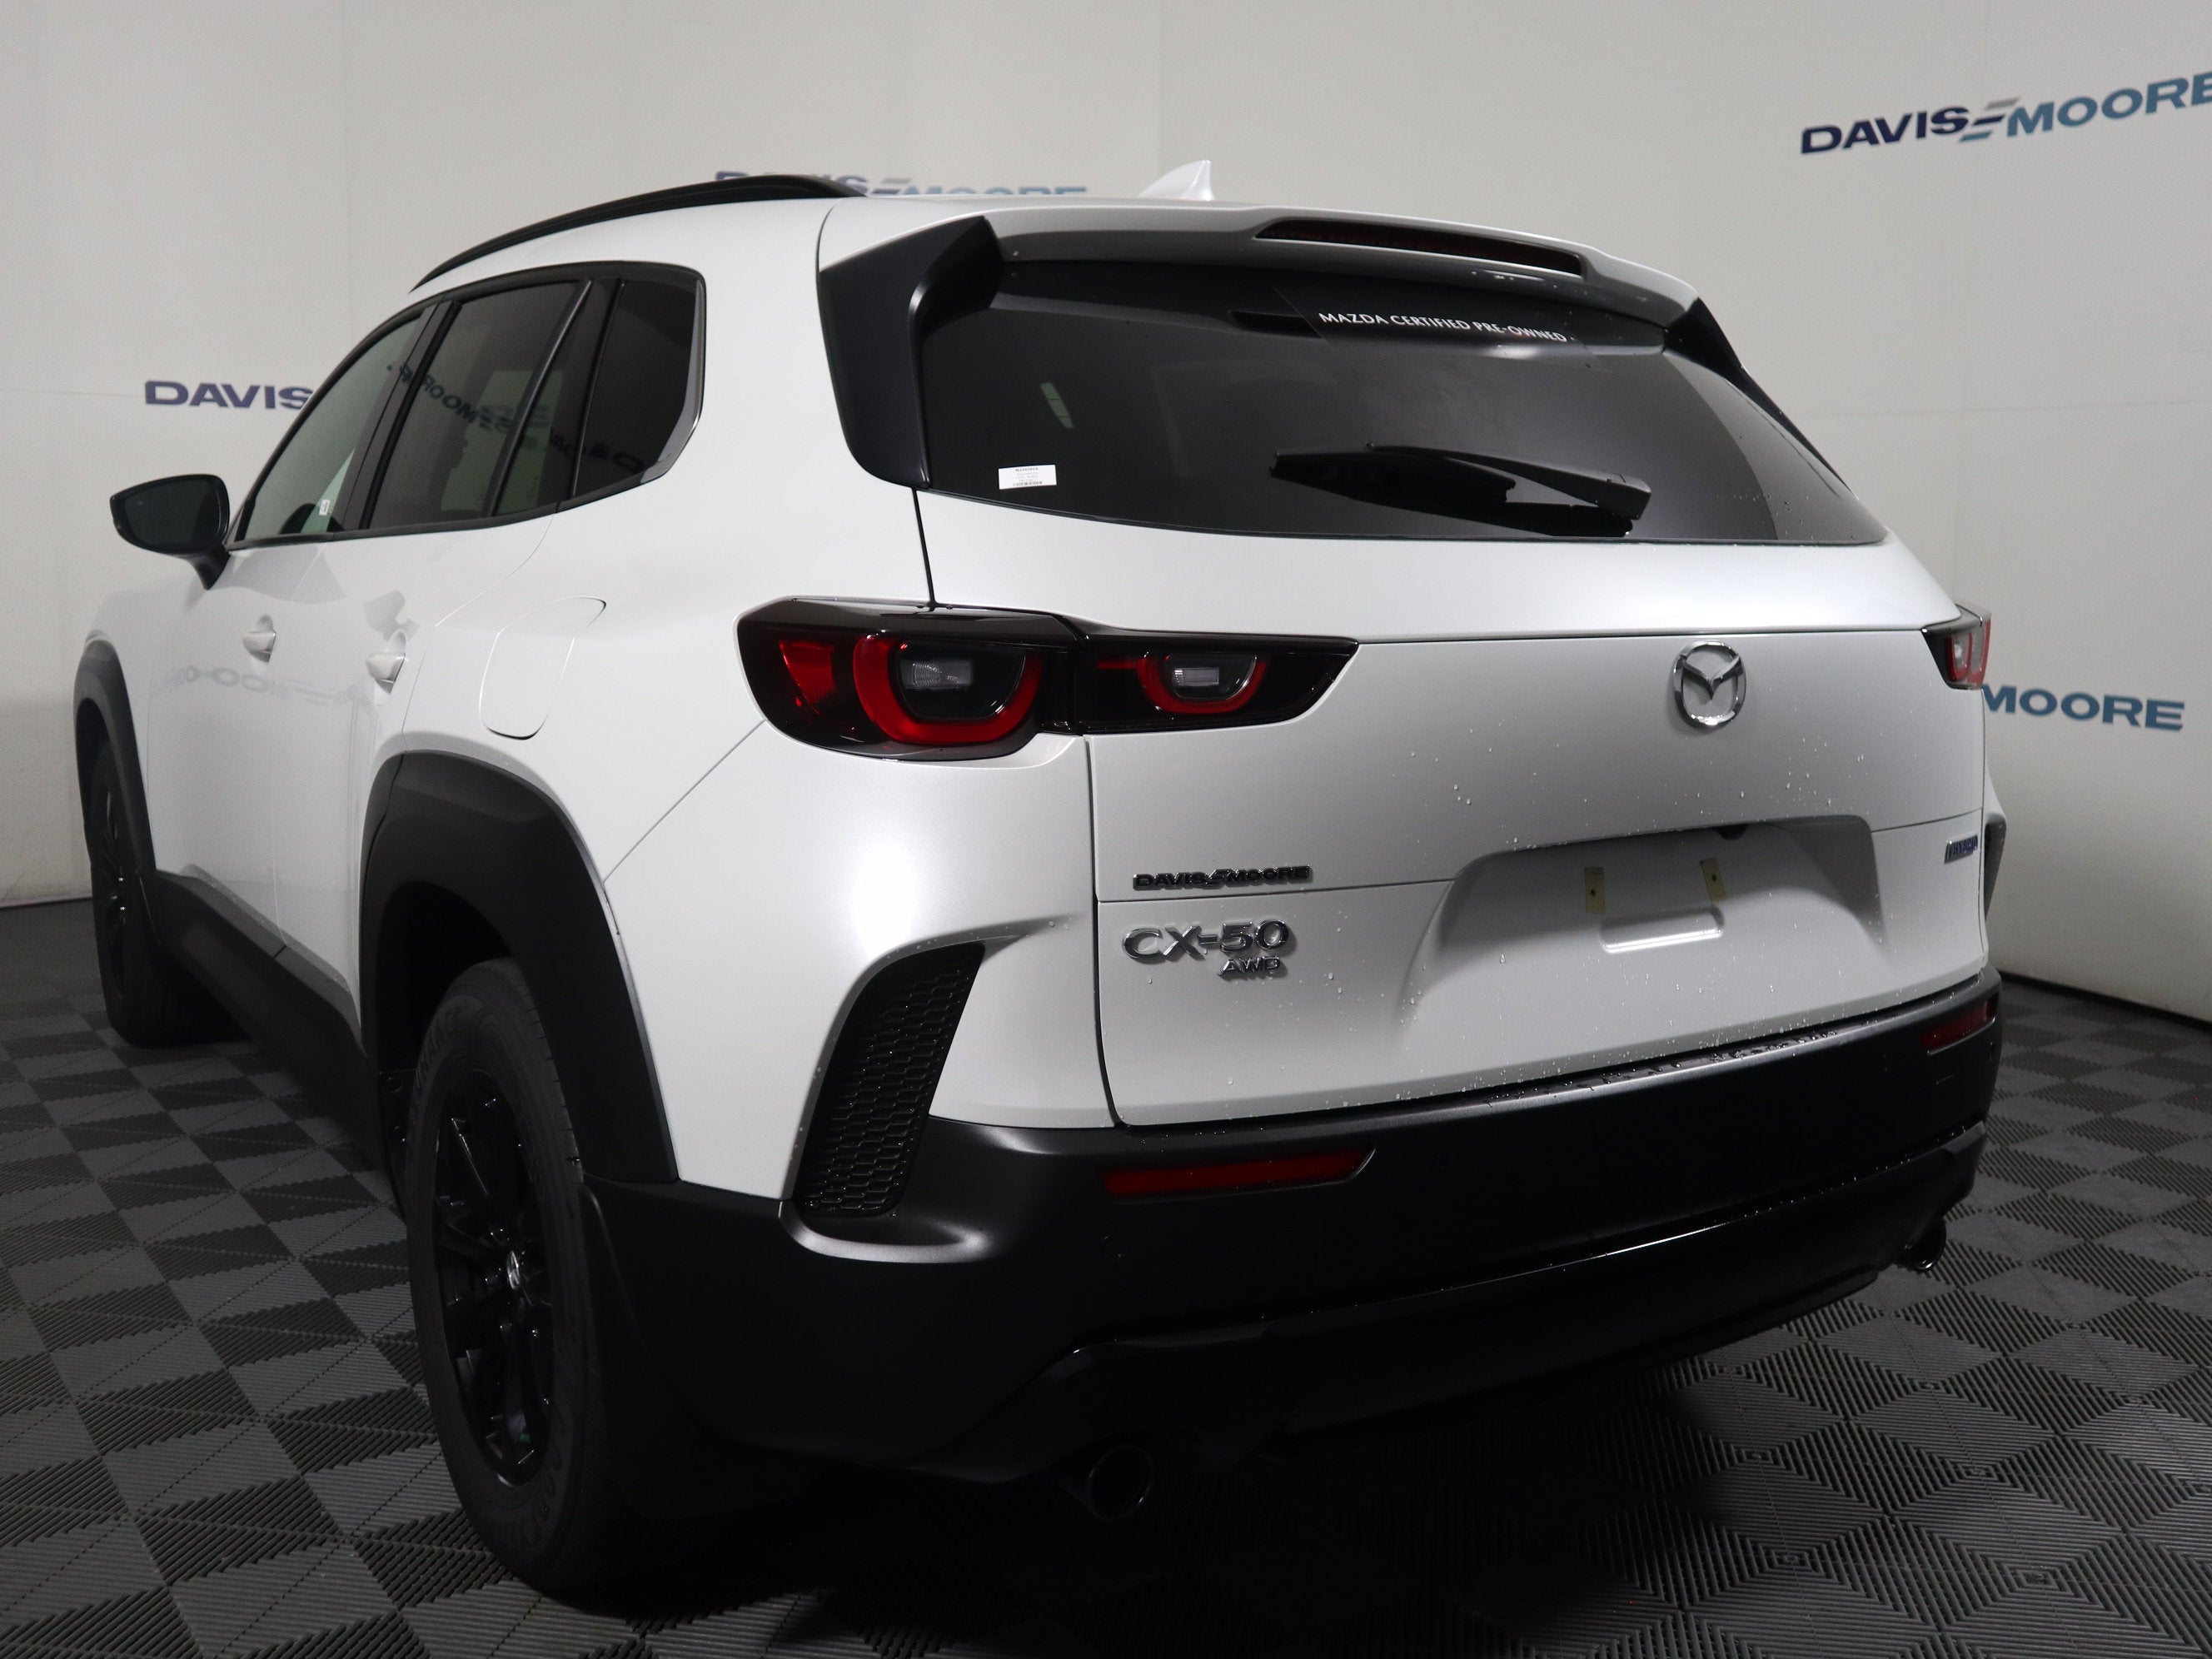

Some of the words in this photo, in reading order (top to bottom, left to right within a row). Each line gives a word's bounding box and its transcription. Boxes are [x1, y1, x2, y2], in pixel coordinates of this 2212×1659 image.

[1801, 106, 1970, 154] DAVIS
[1318, 312, 1389, 325] MAZDA
[1390, 315, 1471, 331] CERTIFIED
[1473, 321, 1567, 342] PRE-OWNED
[144, 379, 314, 411] DAVIS
[1981, 684, 2185, 731] MOORE
[1133, 871, 1207, 890] DAVIS
[1224, 865, 1313, 887] MOORE
[1123, 919, 1290, 960] CX-50
[1217, 955, 1282, 977] AWD
